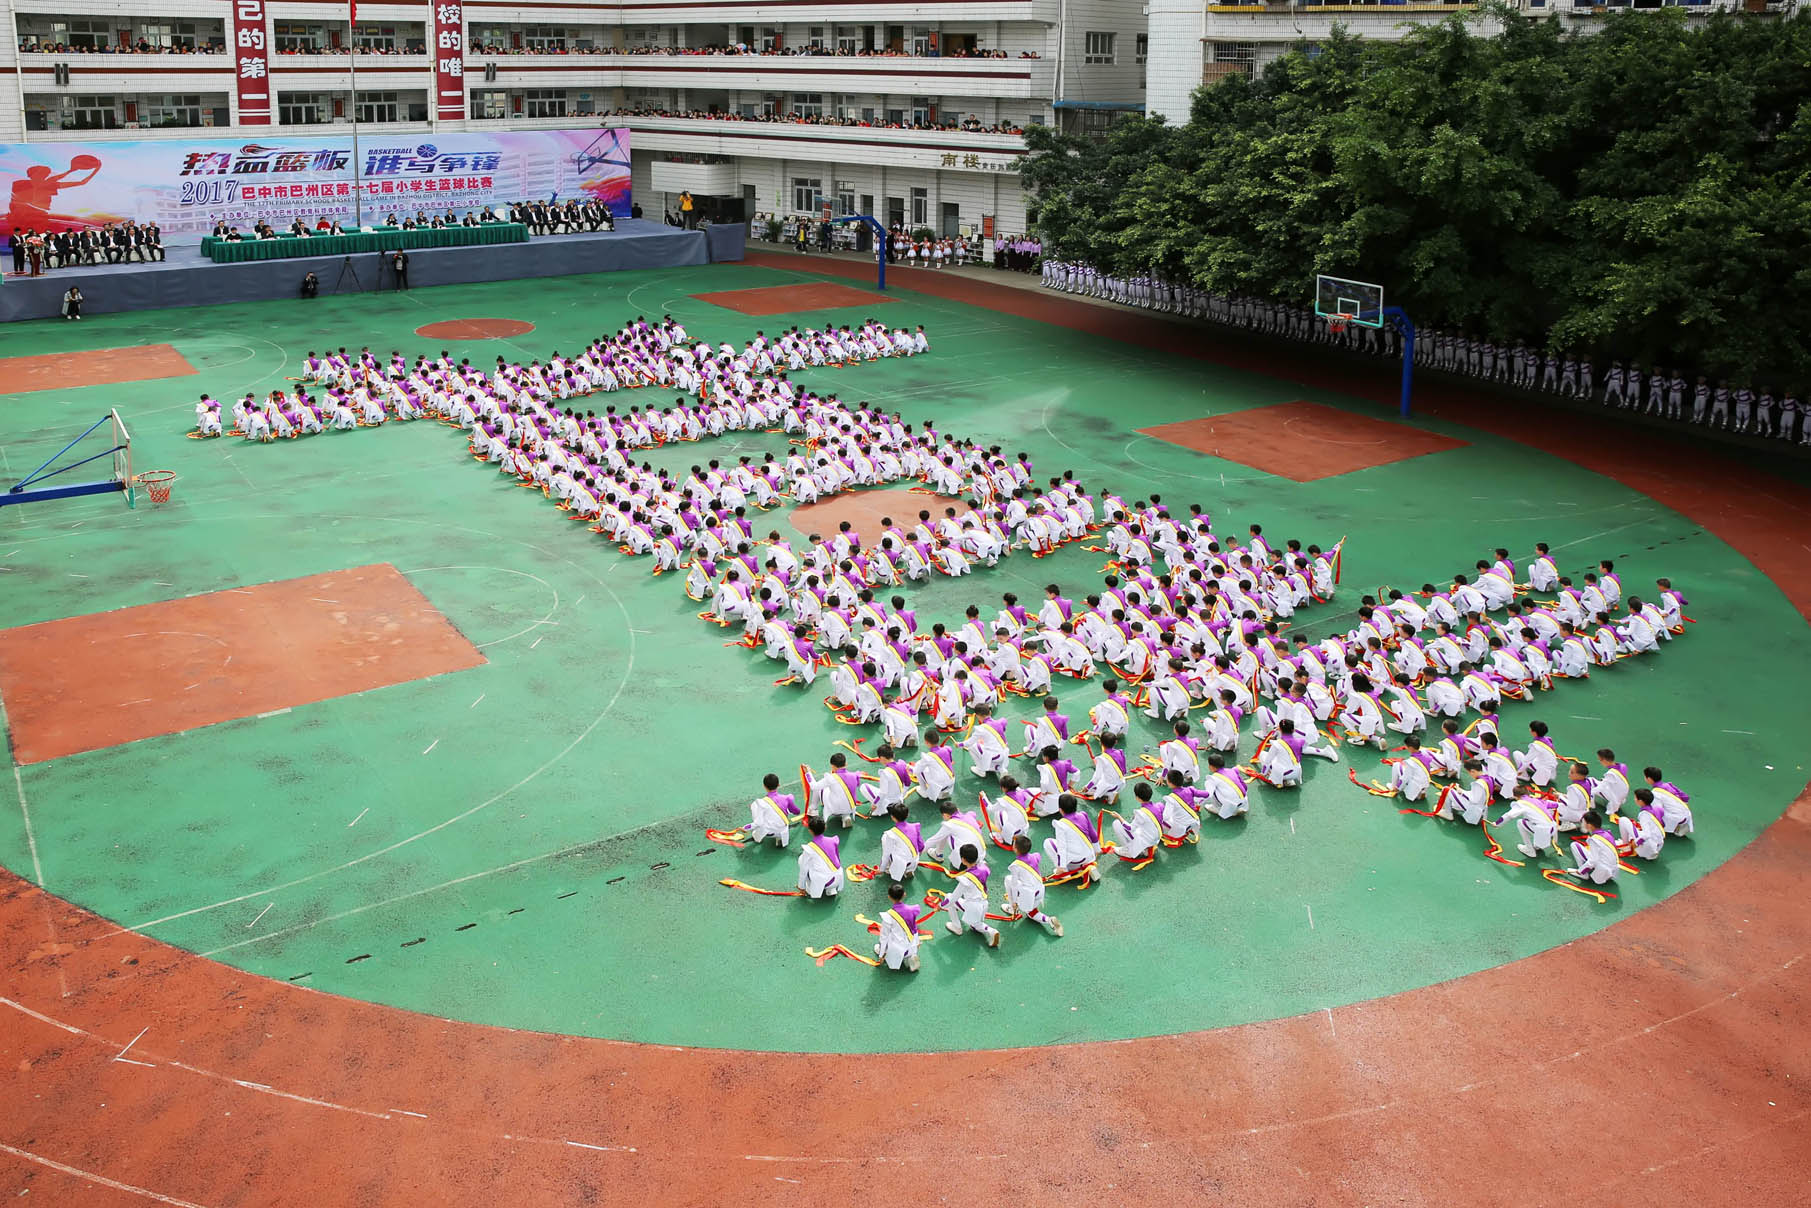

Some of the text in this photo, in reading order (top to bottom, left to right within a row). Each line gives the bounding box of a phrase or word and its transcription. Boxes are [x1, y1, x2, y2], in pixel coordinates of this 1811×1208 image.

[237, 0, 268, 100] 己的第一
[437, 4, 464, 97] 校的唯一
[364, 151, 503, 176] 谁与争锋
[941, 153, 980, 169] 南楼
[181, 180, 240, 205] 2017
[242, 177, 493, 200] 巴中市巴州区第十七届小学生篮球比赛
